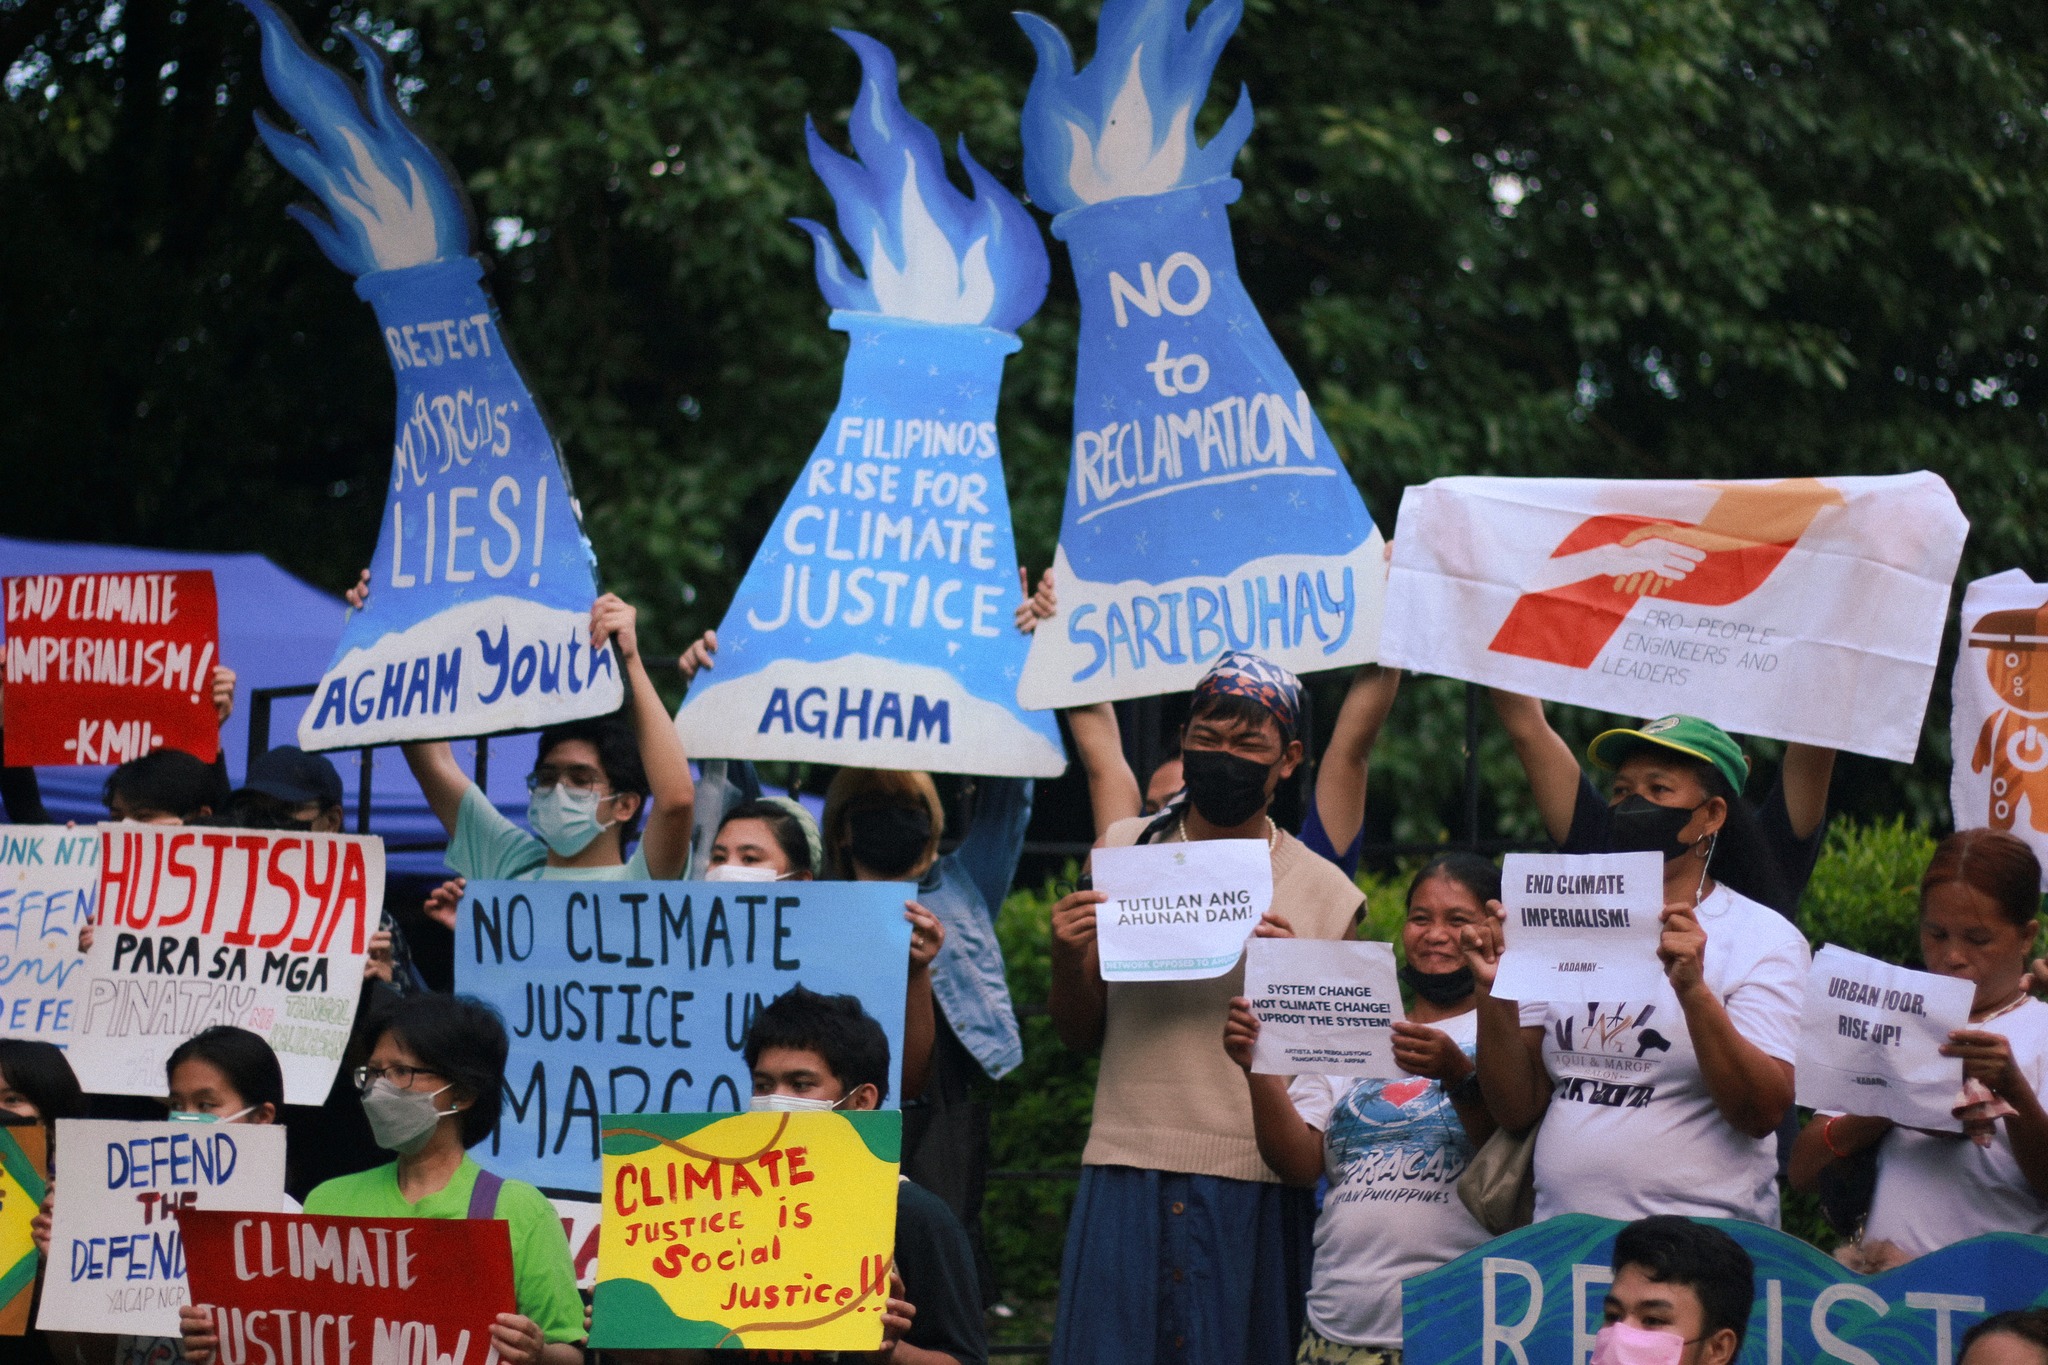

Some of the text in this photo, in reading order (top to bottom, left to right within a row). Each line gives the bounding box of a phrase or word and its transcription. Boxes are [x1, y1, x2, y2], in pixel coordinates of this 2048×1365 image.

[1108, 251, 1212, 327] NO
[385, 313, 492, 370] REJECT
[1145, 340, 1210, 397] to
[835, 416, 998, 460] FILIPINOS
[1075, 389, 1316, 507] RECLAMATION
[807, 459, 989, 515] RISE FOR
[391, 475, 549, 588] LIES!
[782, 504, 997, 571] CLIMATE
[7, 574, 178, 625] END CLIMATE
[746, 562, 1006, 637] JUSTICE
[1067, 565, 1355, 683] SARIBUHAY
[1643, 609, 1776, 646] PRO-PEOPLE
[6, 636, 215, 704] IMPERIALISM!
[1601, 656, 1690, 686] LEADERS
[1622, 632, 1778, 672] ENGINEERS AND
[311, 646, 463, 729] AGHAM
[757, 686, 952, 744] AGHAM
[97, 832, 366, 955] HUSTISYA
[1118, 890, 1250, 912] TUTULAN ANG
[1525, 874, 1625, 895] END CLIMATE
[471, 891, 801, 971] NO CLIMATE
[1118, 905, 1252, 926] AHUNAN DAM!
[1521, 907, 1631, 928] IMPERIALISM!
[112, 932, 329, 993] PARA SA MGA
[1267, 984, 1372, 997] SYSTEM CHANGE
[83, 979, 257, 1038] PINATAY
[512, 980, 694, 1048] JUSTICE
[1252, 999, 1391, 1014] NOT CLIMATE CHANGE!
[1257, 1012, 1392, 1028] UPROOT THE SYSTEM!
[1828, 977, 1881, 1007] URBAN
[1838, 1014, 1902, 1047] RISE UP!
[1604, 1058, 1653, 1073] MARGE
[107, 1132, 238, 1189] DEFEND
[615, 1146, 815, 1217] CLIMATE
[1361, 1187, 1450, 1204] PHILIPPINES
[233, 1218, 419, 1291] CLIMATE
[625, 1210, 745, 1247] JUSTICE
[1482, 1257, 1986, 1365] REIST
